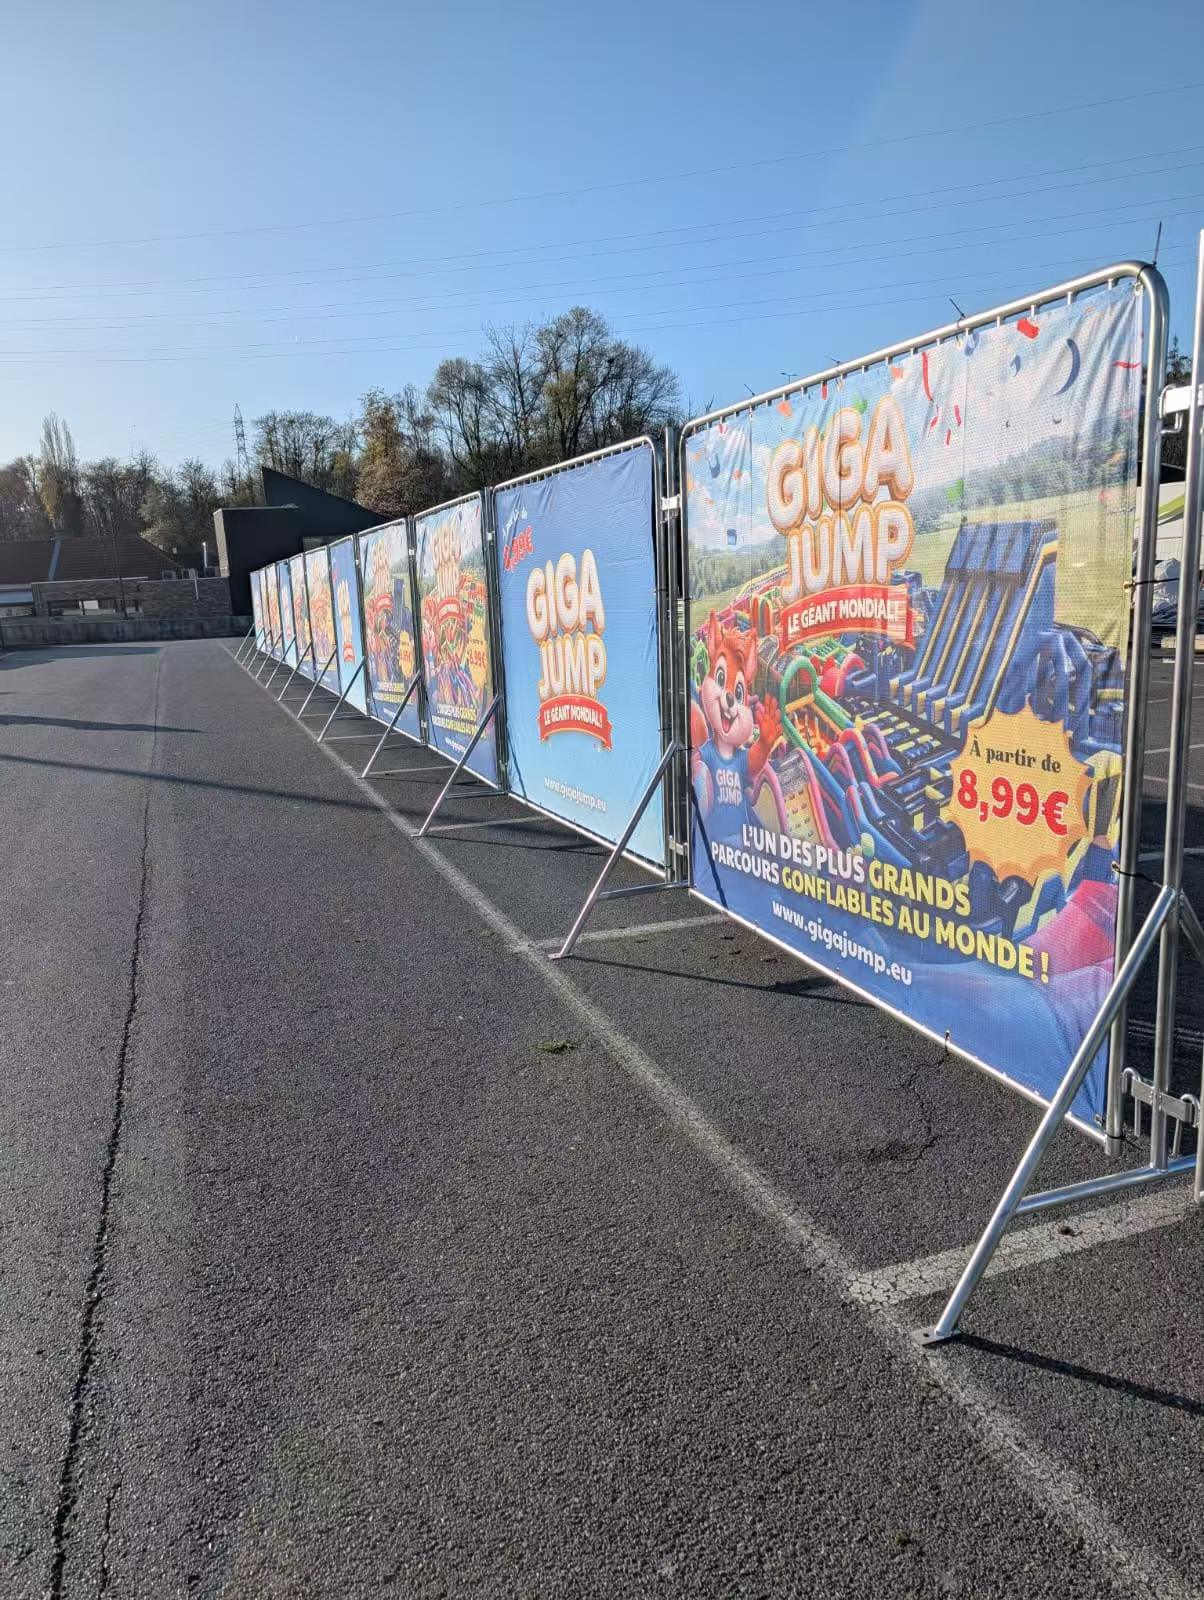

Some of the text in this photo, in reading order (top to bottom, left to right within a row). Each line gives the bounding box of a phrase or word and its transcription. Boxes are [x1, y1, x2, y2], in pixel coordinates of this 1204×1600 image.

[767, 394, 914, 536] GIGA
[781, 500, 915, 606] JUMP
[526, 549, 606, 645] GIGA
[787, 613, 801, 635] LE
[801, 602, 837, 629] GÉANT
[538, 630, 607, 704] JUMP
[543, 709, 551, 726] LE
[551, 703, 570, 722] GÉANT
[716, 768, 741, 790] GIGA
[970, 734, 1061, 773] À partir de
[718, 786, 742, 807] JUMP
[957, 768, 1070, 836] 8,99€
[742, 823, 971, 917] L'UN DES PLUS GRANDS
[711, 841, 780, 885] PARCOURS
[781, 865, 894, 927] GONFLABLES
[898, 904, 930, 939] AU
[935, 916, 1034, 979] MONDE
[772, 900, 912, 986] www.gigajump.eu
